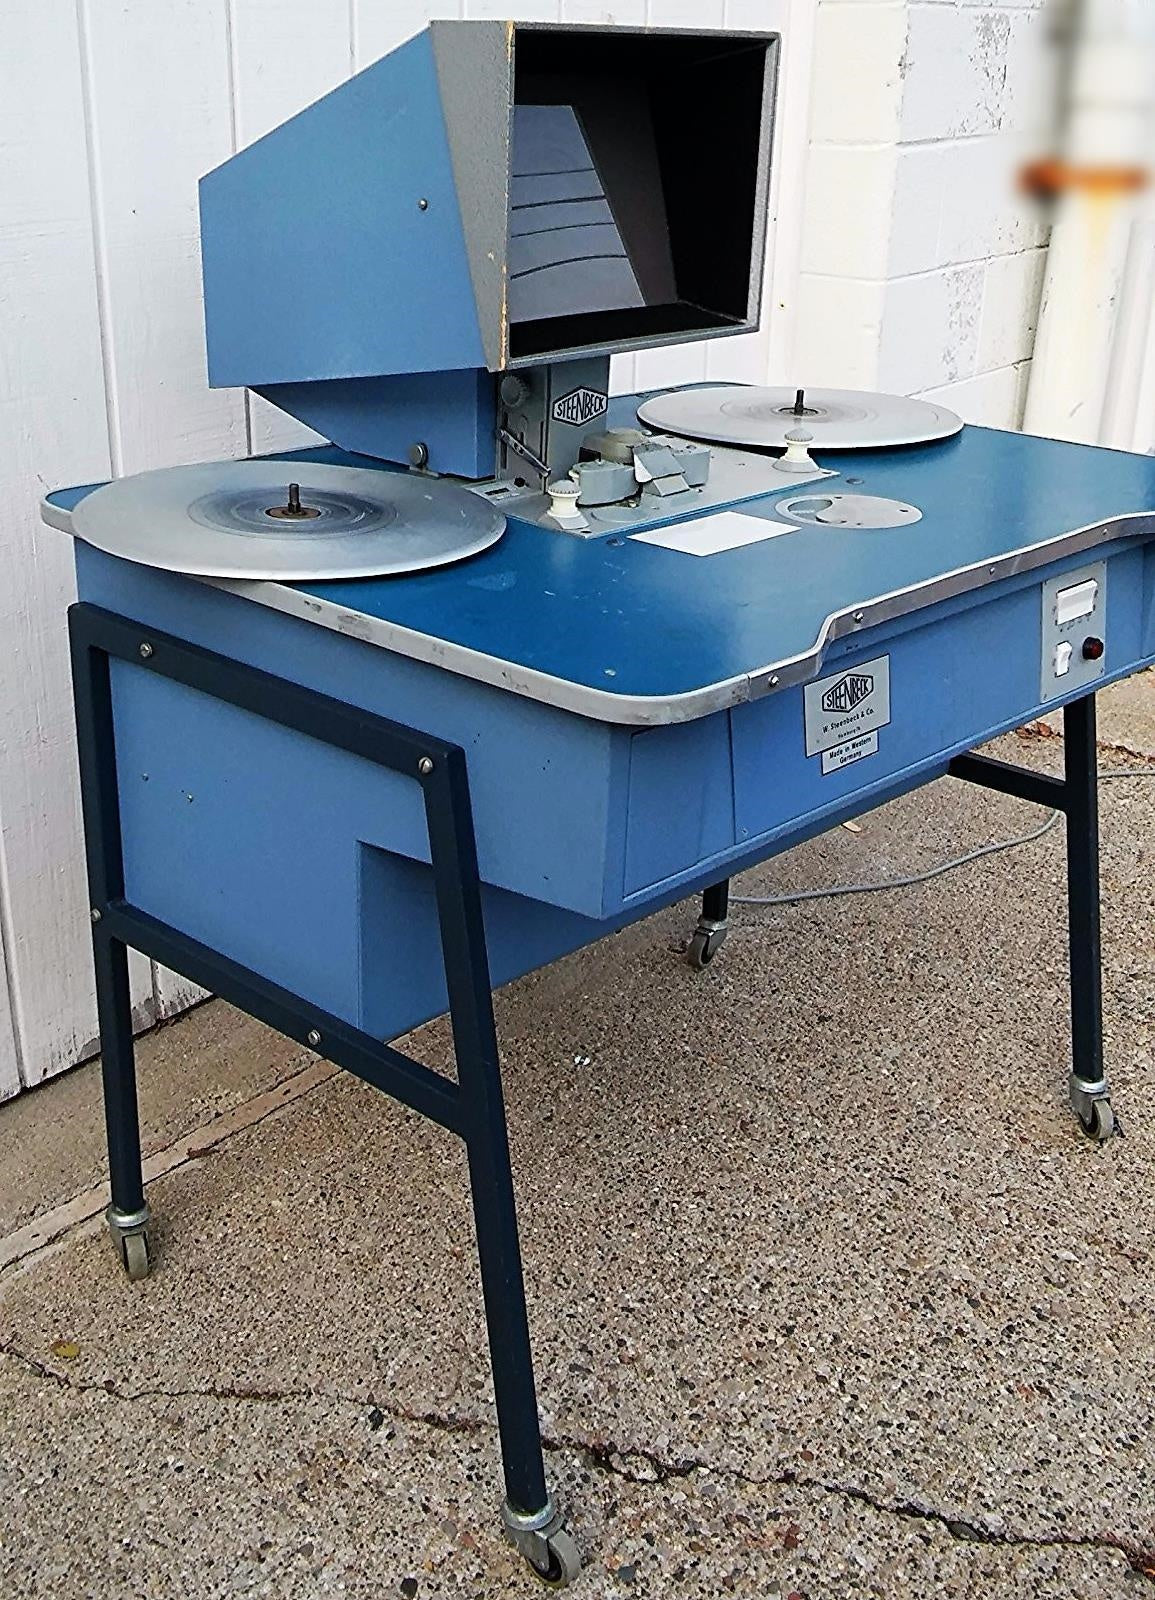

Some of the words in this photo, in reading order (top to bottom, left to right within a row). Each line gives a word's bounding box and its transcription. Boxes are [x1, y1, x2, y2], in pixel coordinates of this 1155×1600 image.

[556, 391, 605, 421] STEENBECK
[826, 677, 869, 710] STEENBECK
[830, 713, 860, 730] Steenbeck
[860, 710, 865, 718] &
[829, 749, 843, 759] Made
[851, 737, 872, 749] Western
[839, 751, 862, 764] Germany
